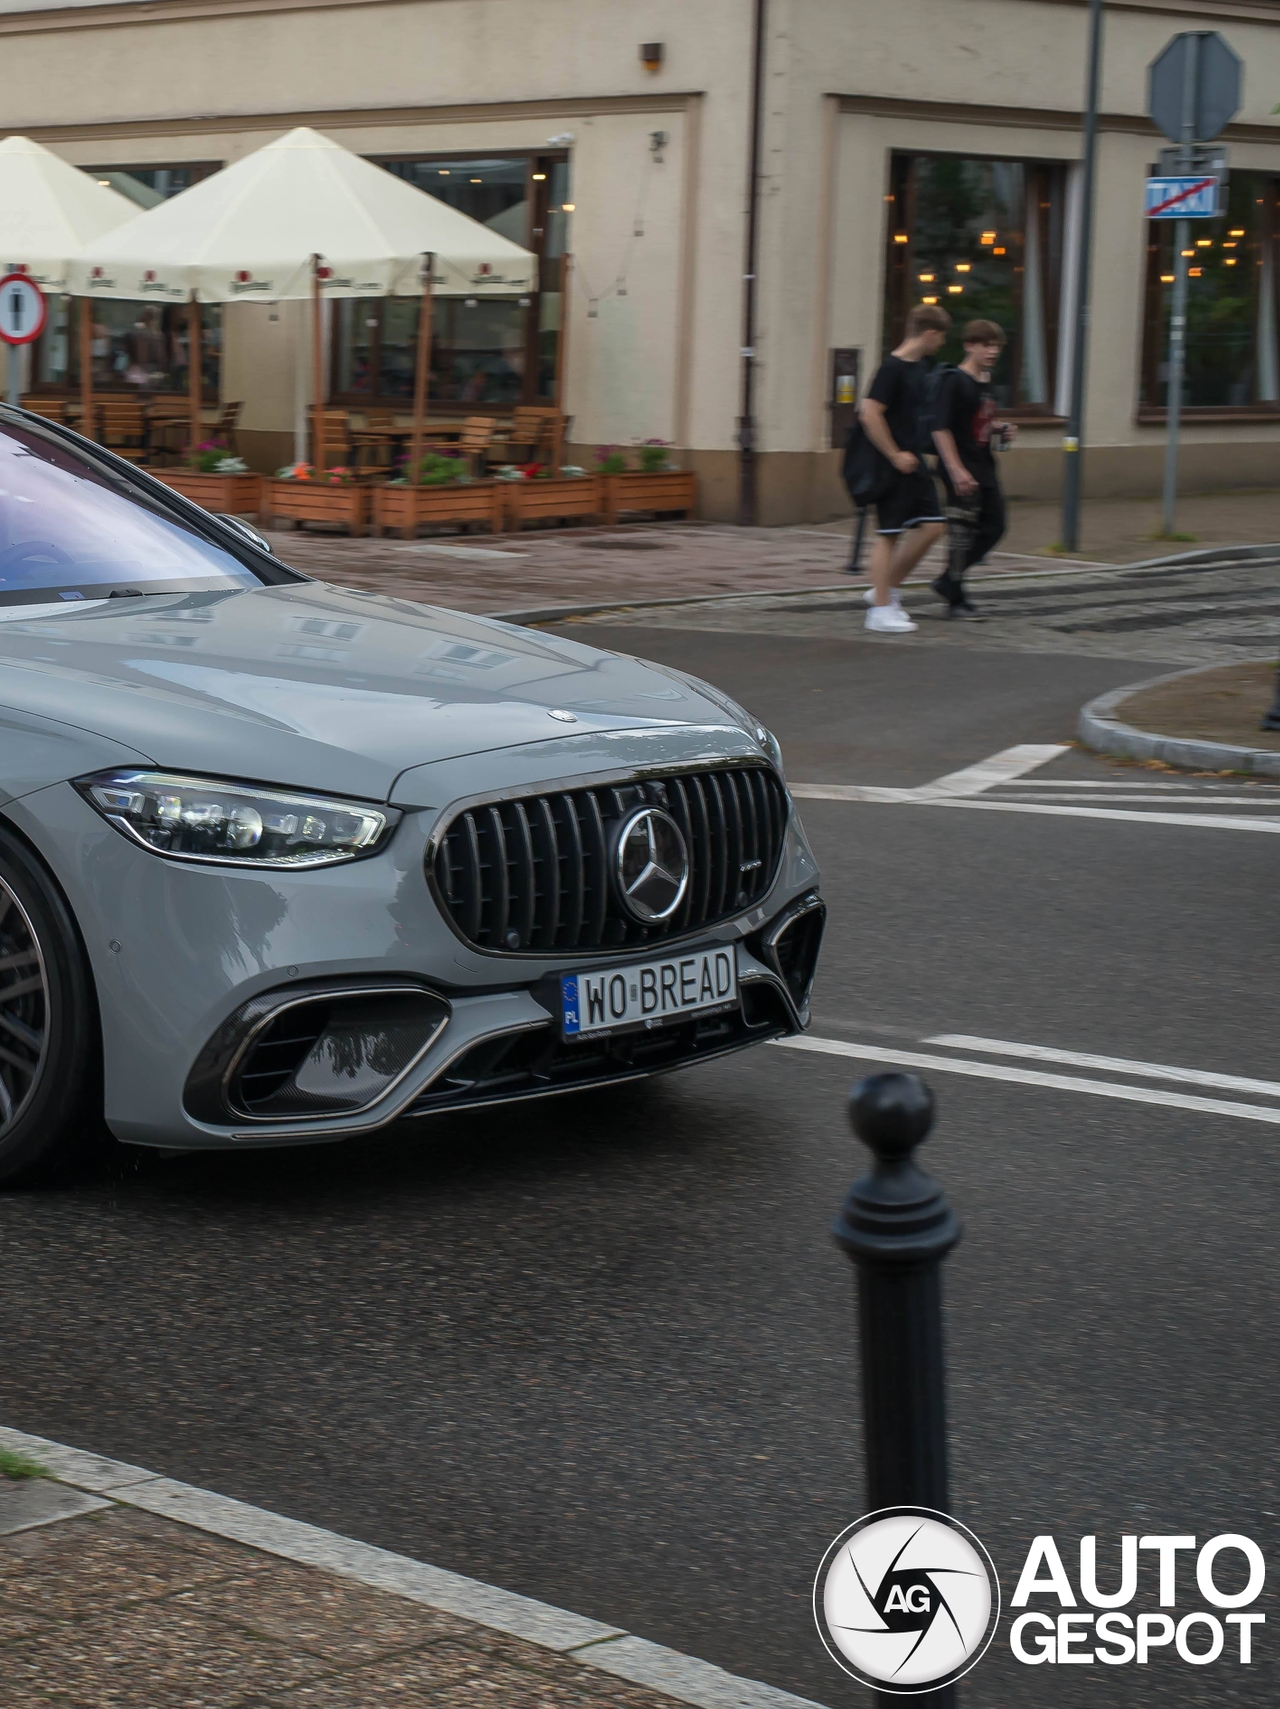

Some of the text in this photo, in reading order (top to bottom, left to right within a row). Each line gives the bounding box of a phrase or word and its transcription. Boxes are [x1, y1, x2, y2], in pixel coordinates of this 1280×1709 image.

[1146, 183, 1214, 213] TAXI
[584, 952, 731, 1024] WO BREAD
[564, 1010, 579, 1025] PL
